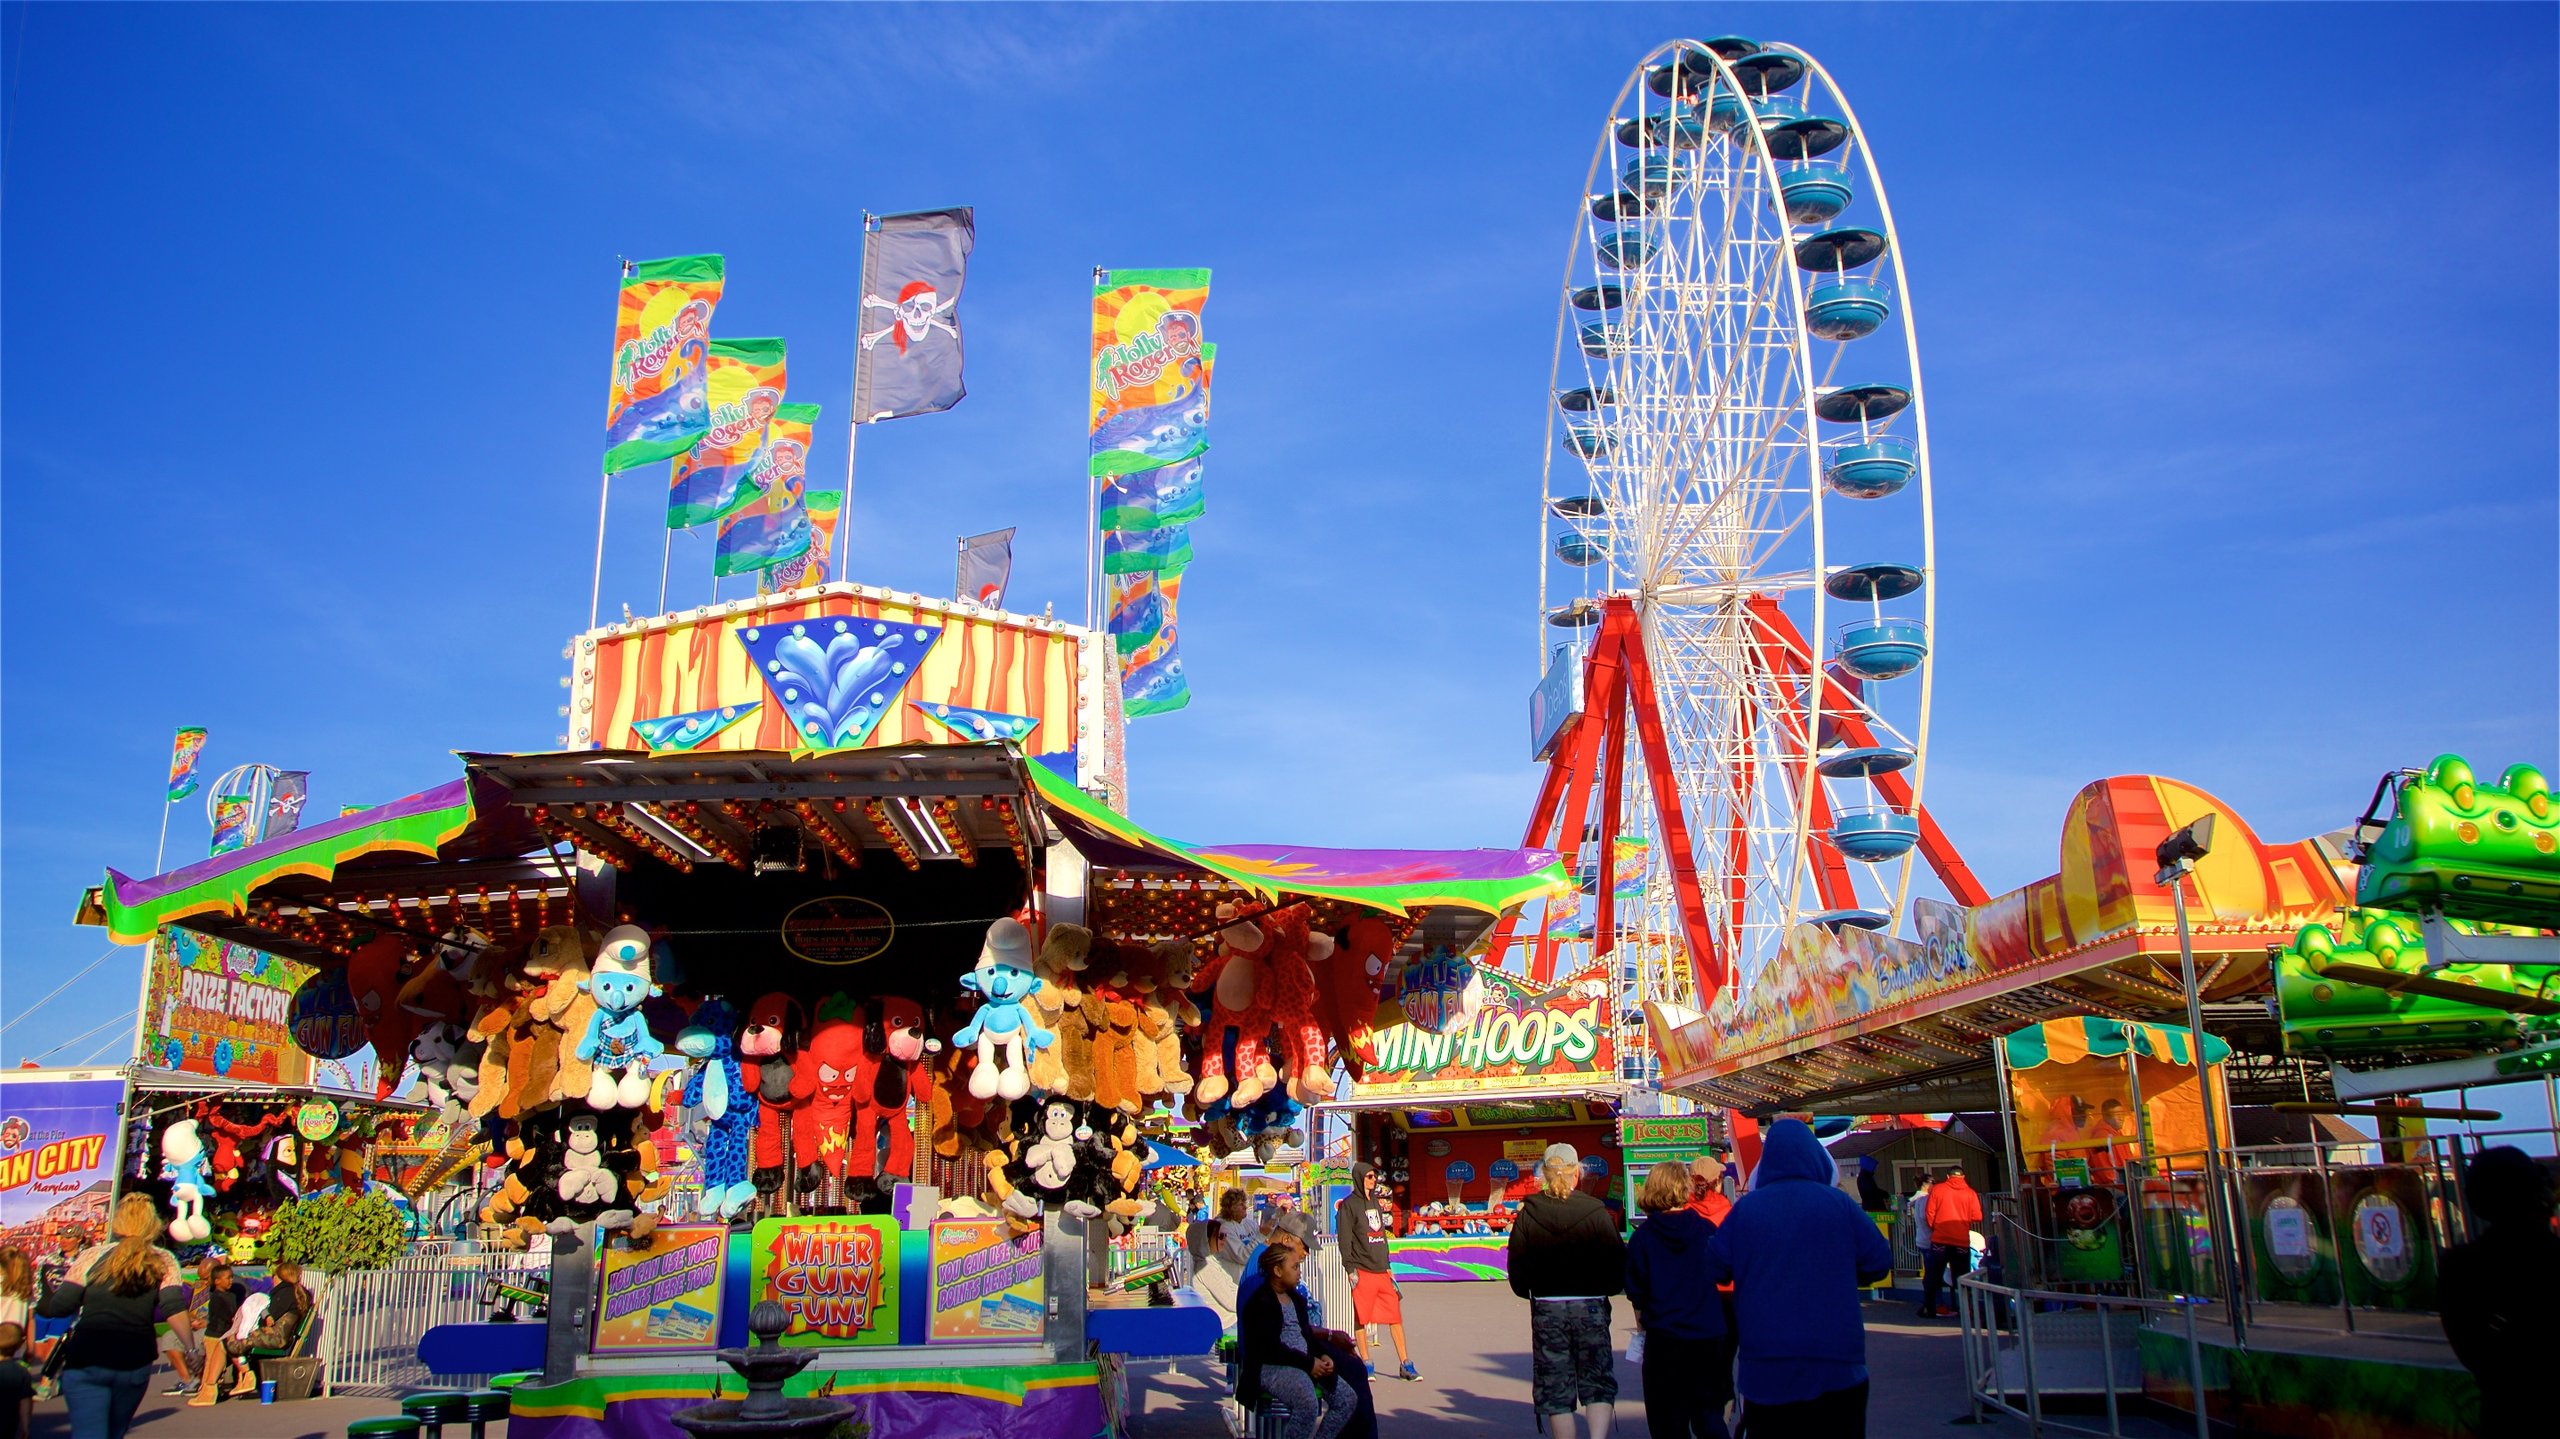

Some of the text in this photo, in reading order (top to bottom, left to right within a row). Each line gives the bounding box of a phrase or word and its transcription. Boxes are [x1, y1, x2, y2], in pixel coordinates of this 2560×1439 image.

[631, 333, 681, 381] Roger
[634, 325, 677, 362] Jolly
[1115, 333, 1164, 366] Jolly
[1110, 345, 1174, 388] Roger
[711, 404, 746, 428] olly
[2394, 825, 2411, 849] 10
[1403, 956, 1476, 992] WATER
[1873, 936, 1969, 999] Bumper Cars
[182, 968, 292, 1026] PRIZE FACTORY
[1404, 991, 1439, 1030] GUN
[297, 1015, 333, 1056] GUN
[1364, 994, 1602, 1074] MINI HOOPS
[38, 1131, 50, 1140] the
[51, 1129, 66, 1140] Pier
[1626, 1121, 1704, 1142] TICKETS
[36, 1134, 107, 1180] CITY
[26, 1180, 81, 1197] Maryland
[608, 1265, 636, 1295] YOU
[634, 1255, 662, 1286] CAN
[661, 1246, 687, 1277] USE
[687, 1235, 720, 1267] YOUR
[783, 1232, 873, 1267] WATER
[937, 1257, 963, 1287] YOU
[963, 1247, 988, 1277] CAN
[988, 1239, 1012, 1268] USE
[605, 1260, 718, 1321] POINTS HERE TOO!
[775, 1265, 873, 1295] GUN
[937, 1253, 1043, 1313] POINTS HERE TOO!
[781, 1295, 868, 1326] FUN!
